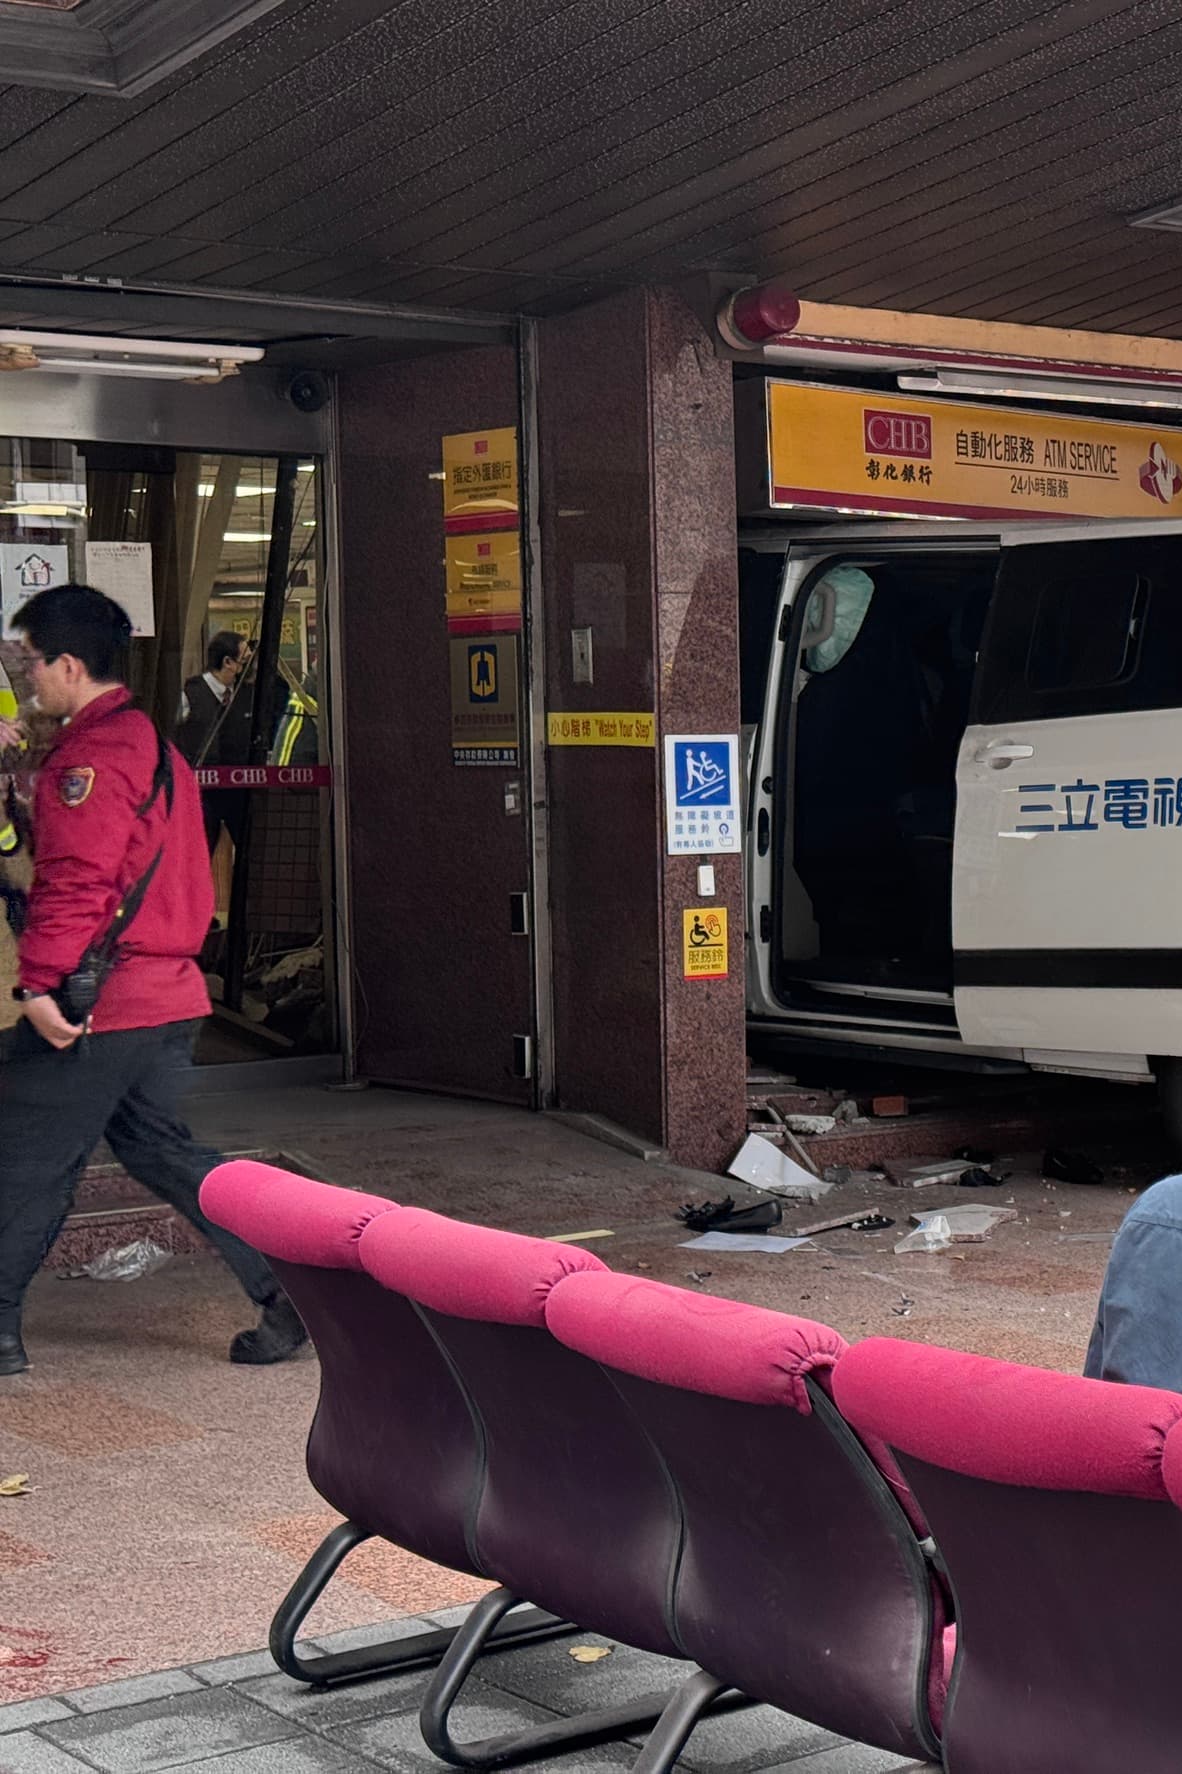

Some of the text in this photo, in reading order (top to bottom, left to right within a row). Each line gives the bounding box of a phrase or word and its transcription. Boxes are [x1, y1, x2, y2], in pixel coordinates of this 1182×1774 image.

[868, 416, 929, 453] CHB
[955, 430, 1118, 474] 自動化服務 ATM SERVICE
[865, 458, 932, 486] 彰化銀行
[1011, 475, 1069, 498] 24小時服務
[550, 719, 591, 738] 小心階梯
[618, 719, 633, 738] Your
[195, 767, 314, 785] HB CHB CHB
[674, 823, 709, 835] 服務鈴
